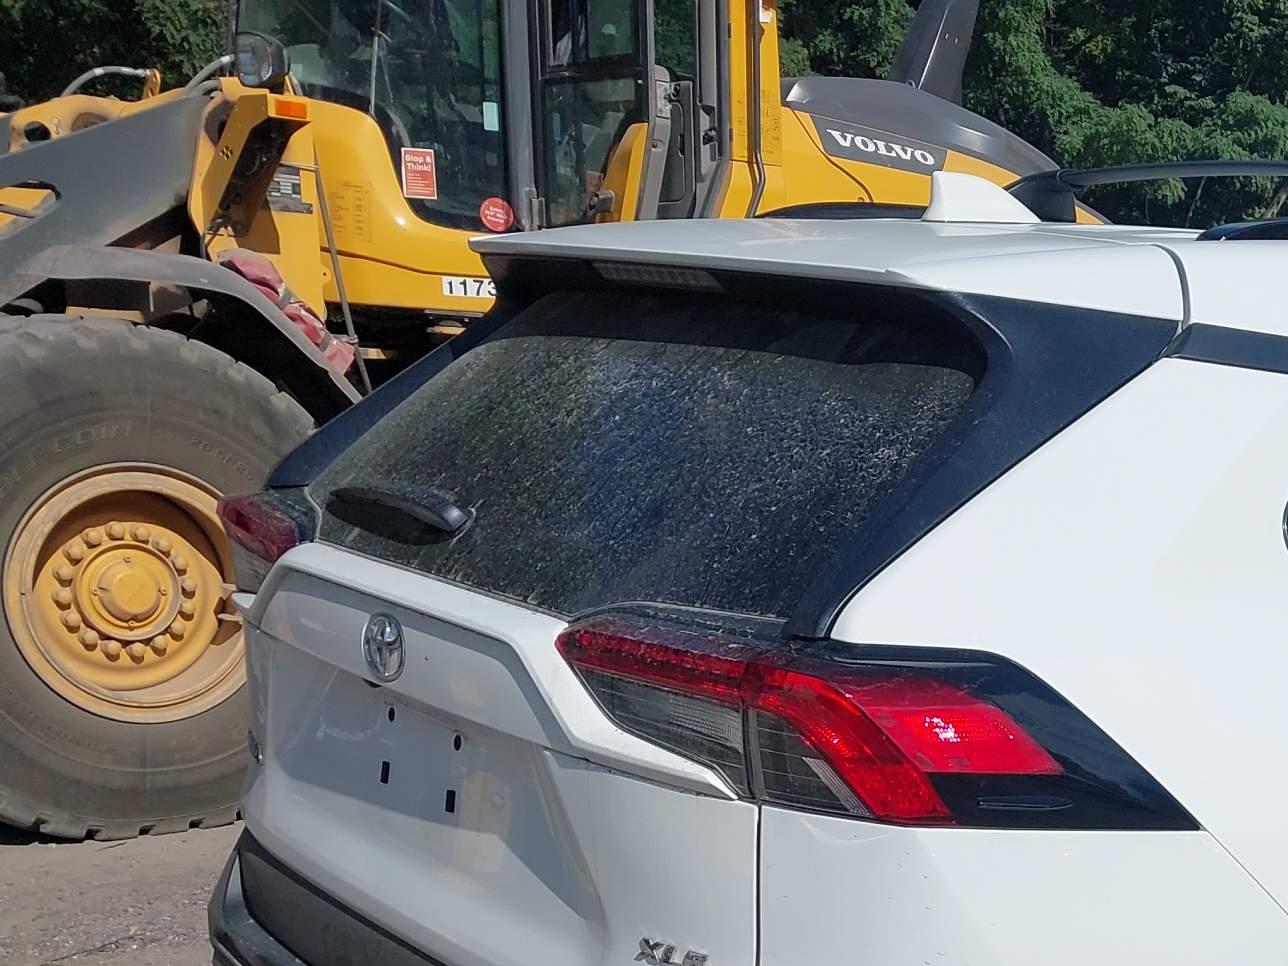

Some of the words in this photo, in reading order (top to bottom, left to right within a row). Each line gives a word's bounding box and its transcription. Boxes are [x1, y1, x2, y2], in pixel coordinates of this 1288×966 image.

[826, 129, 935, 165] VOLVO
[405, 154, 424, 164] Stop
[446, 279, 497, 297] 1173
